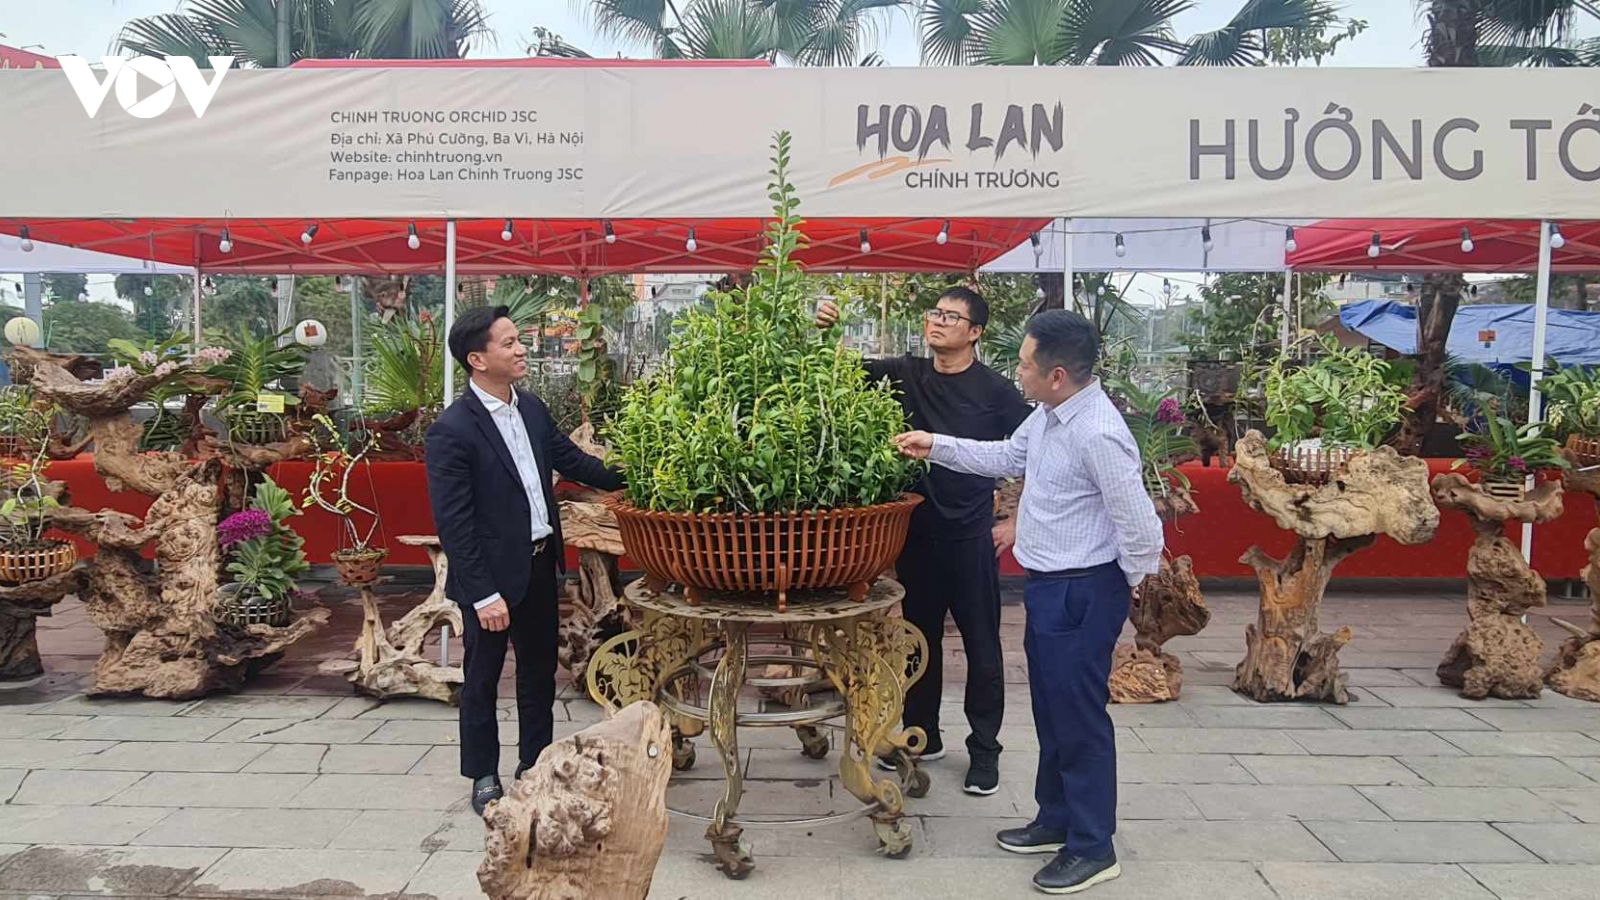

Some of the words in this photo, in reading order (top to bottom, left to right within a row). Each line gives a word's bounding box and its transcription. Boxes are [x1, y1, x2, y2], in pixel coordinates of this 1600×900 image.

[330, 111, 378, 123] CHINH
[381, 111, 445, 123] TRUONG
[449, 110, 507, 123] ORCHID
[511, 110, 537, 122] JSC
[330, 132, 353, 148] Địa
[357, 131, 382, 145] chỉ:
[386, 131, 403, 145] Xã
[408, 131, 434, 145] Phú
[493, 132, 510, 145] Ba
[514, 131, 532, 146] Vì,
[537, 132, 555, 145] Hà
[560, 131, 584, 147] Nội
[857, 104, 952, 164] HOA
[966, 98, 1064, 166] LAN
[1189, 101, 1484, 181] HƯỚNG
[330, 151, 392, 163] Website:
[395, 150, 503, 166] chinhtruong.vn
[329, 168, 393, 184] Fanpage:
[397, 169, 425, 181] Hoa
[429, 169, 454, 181] Lan
[457, 168, 499, 181] Chinh
[503, 168, 553, 184] Truong
[557, 168, 584, 180] JSC
[905, 168, 969, 189] CHÍNH
